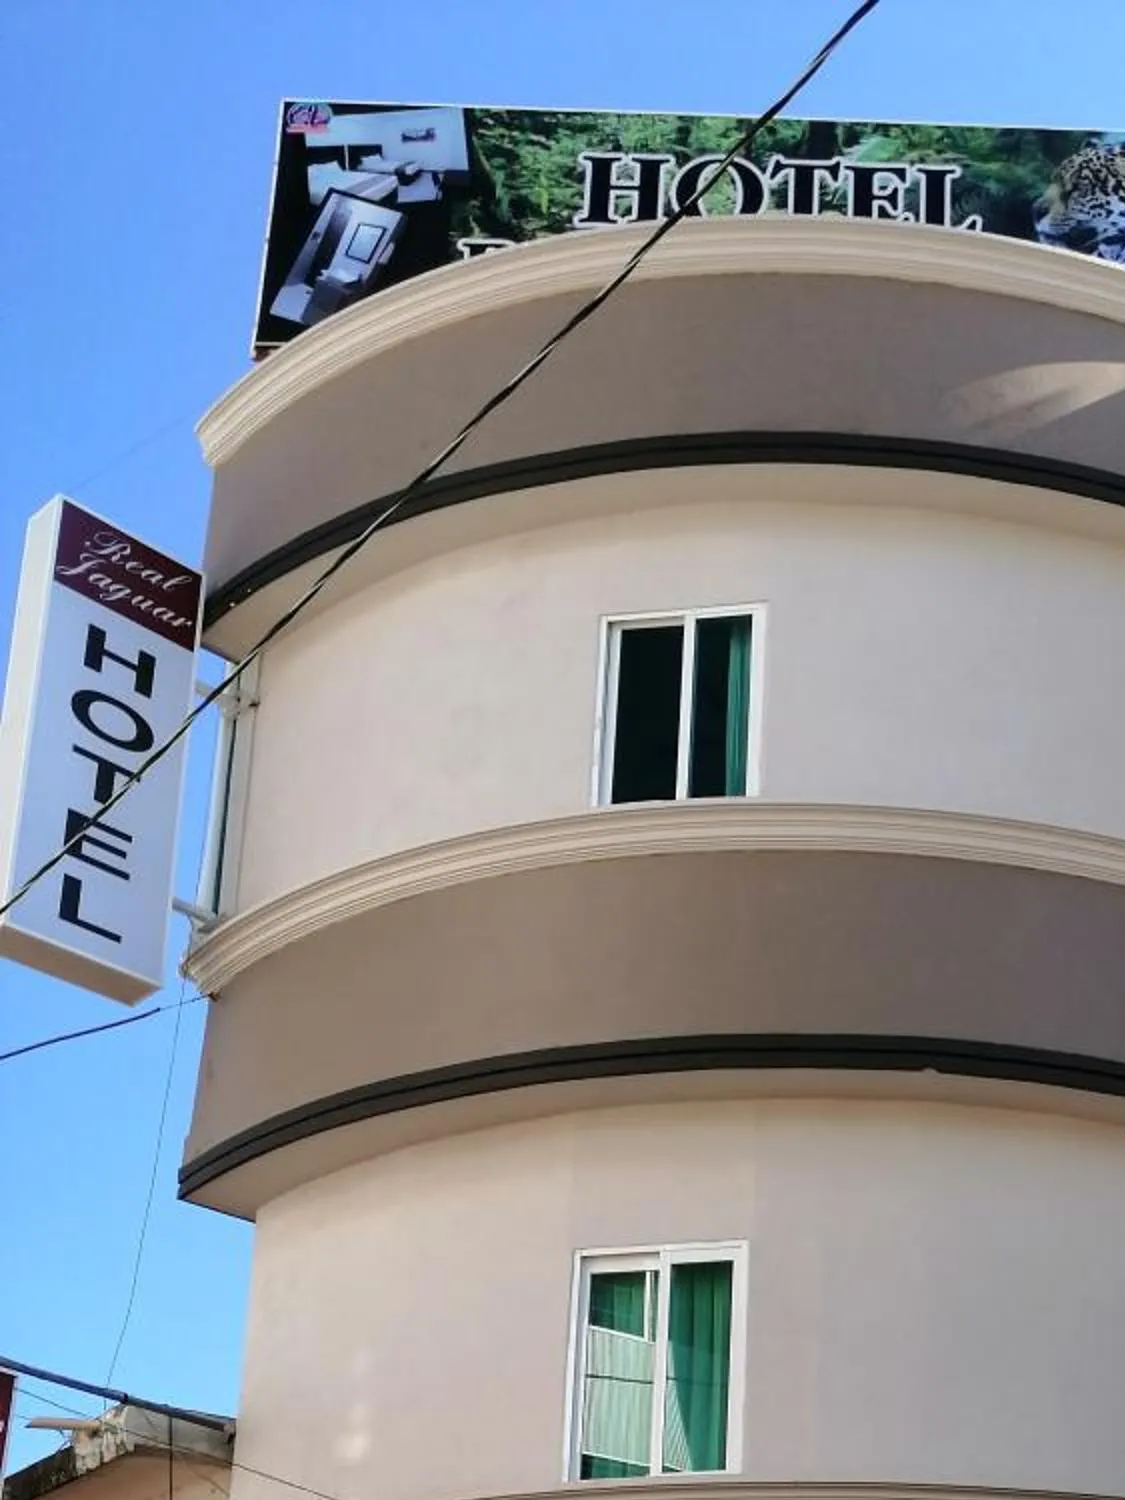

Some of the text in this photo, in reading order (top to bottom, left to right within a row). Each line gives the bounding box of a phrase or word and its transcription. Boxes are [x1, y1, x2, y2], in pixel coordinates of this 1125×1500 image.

[573, 152, 983, 233] HOTEL
[55, 551, 194, 632] Jaguar
[85, 530, 193, 593] Real
[58, 622, 157, 945] HOTEL
